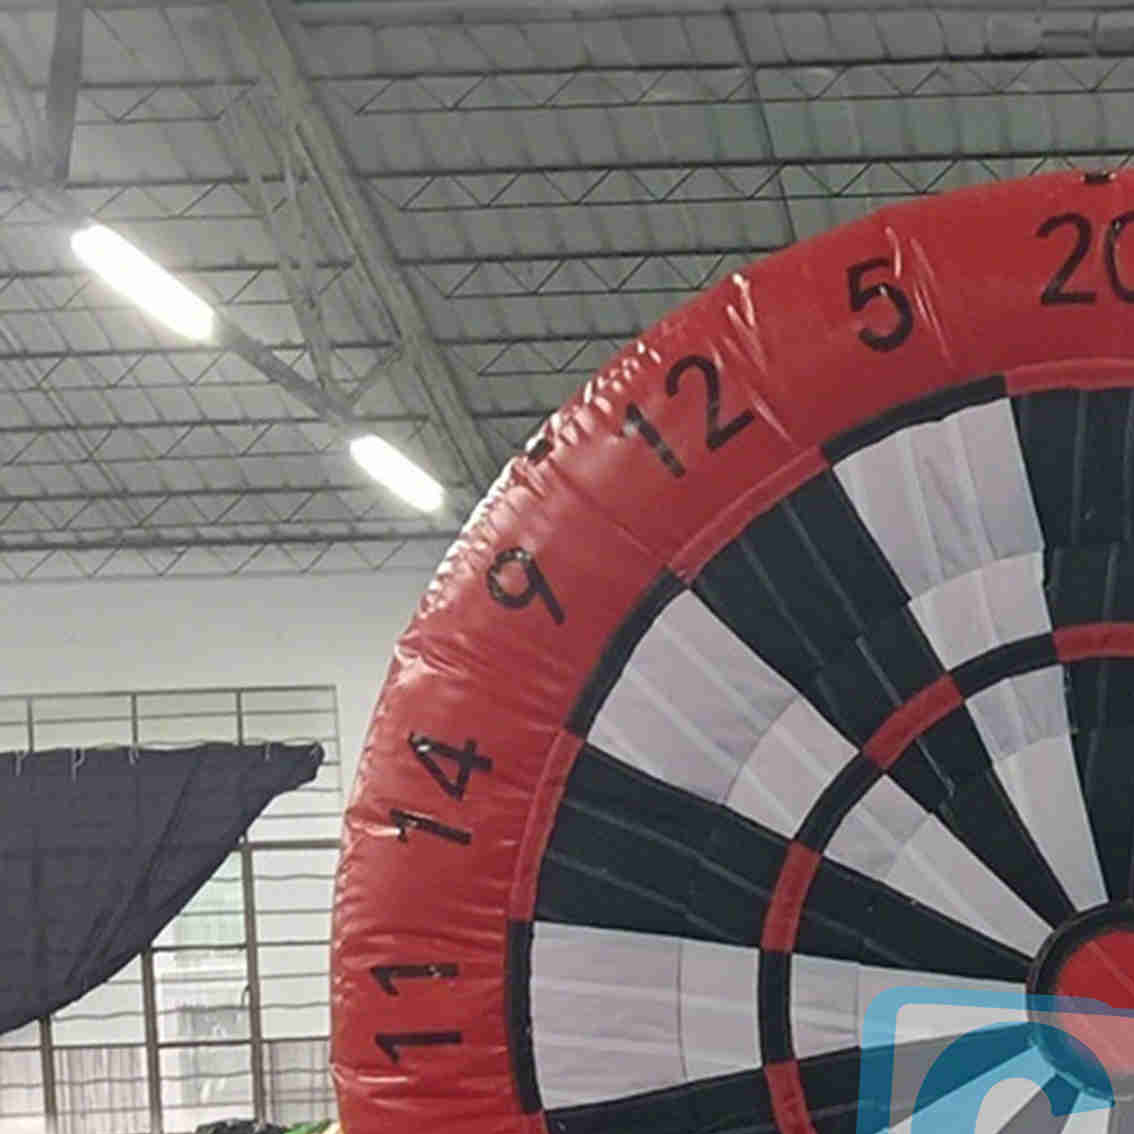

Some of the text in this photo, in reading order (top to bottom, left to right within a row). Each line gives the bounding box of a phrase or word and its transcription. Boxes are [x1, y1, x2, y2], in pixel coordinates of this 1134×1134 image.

[847, 258, 914, 352] 5
[617, 352, 754, 477] 12
[488, 547, 566, 624] 9
[390, 733, 493, 846] 14
[370, 963, 463, 1064] 11
